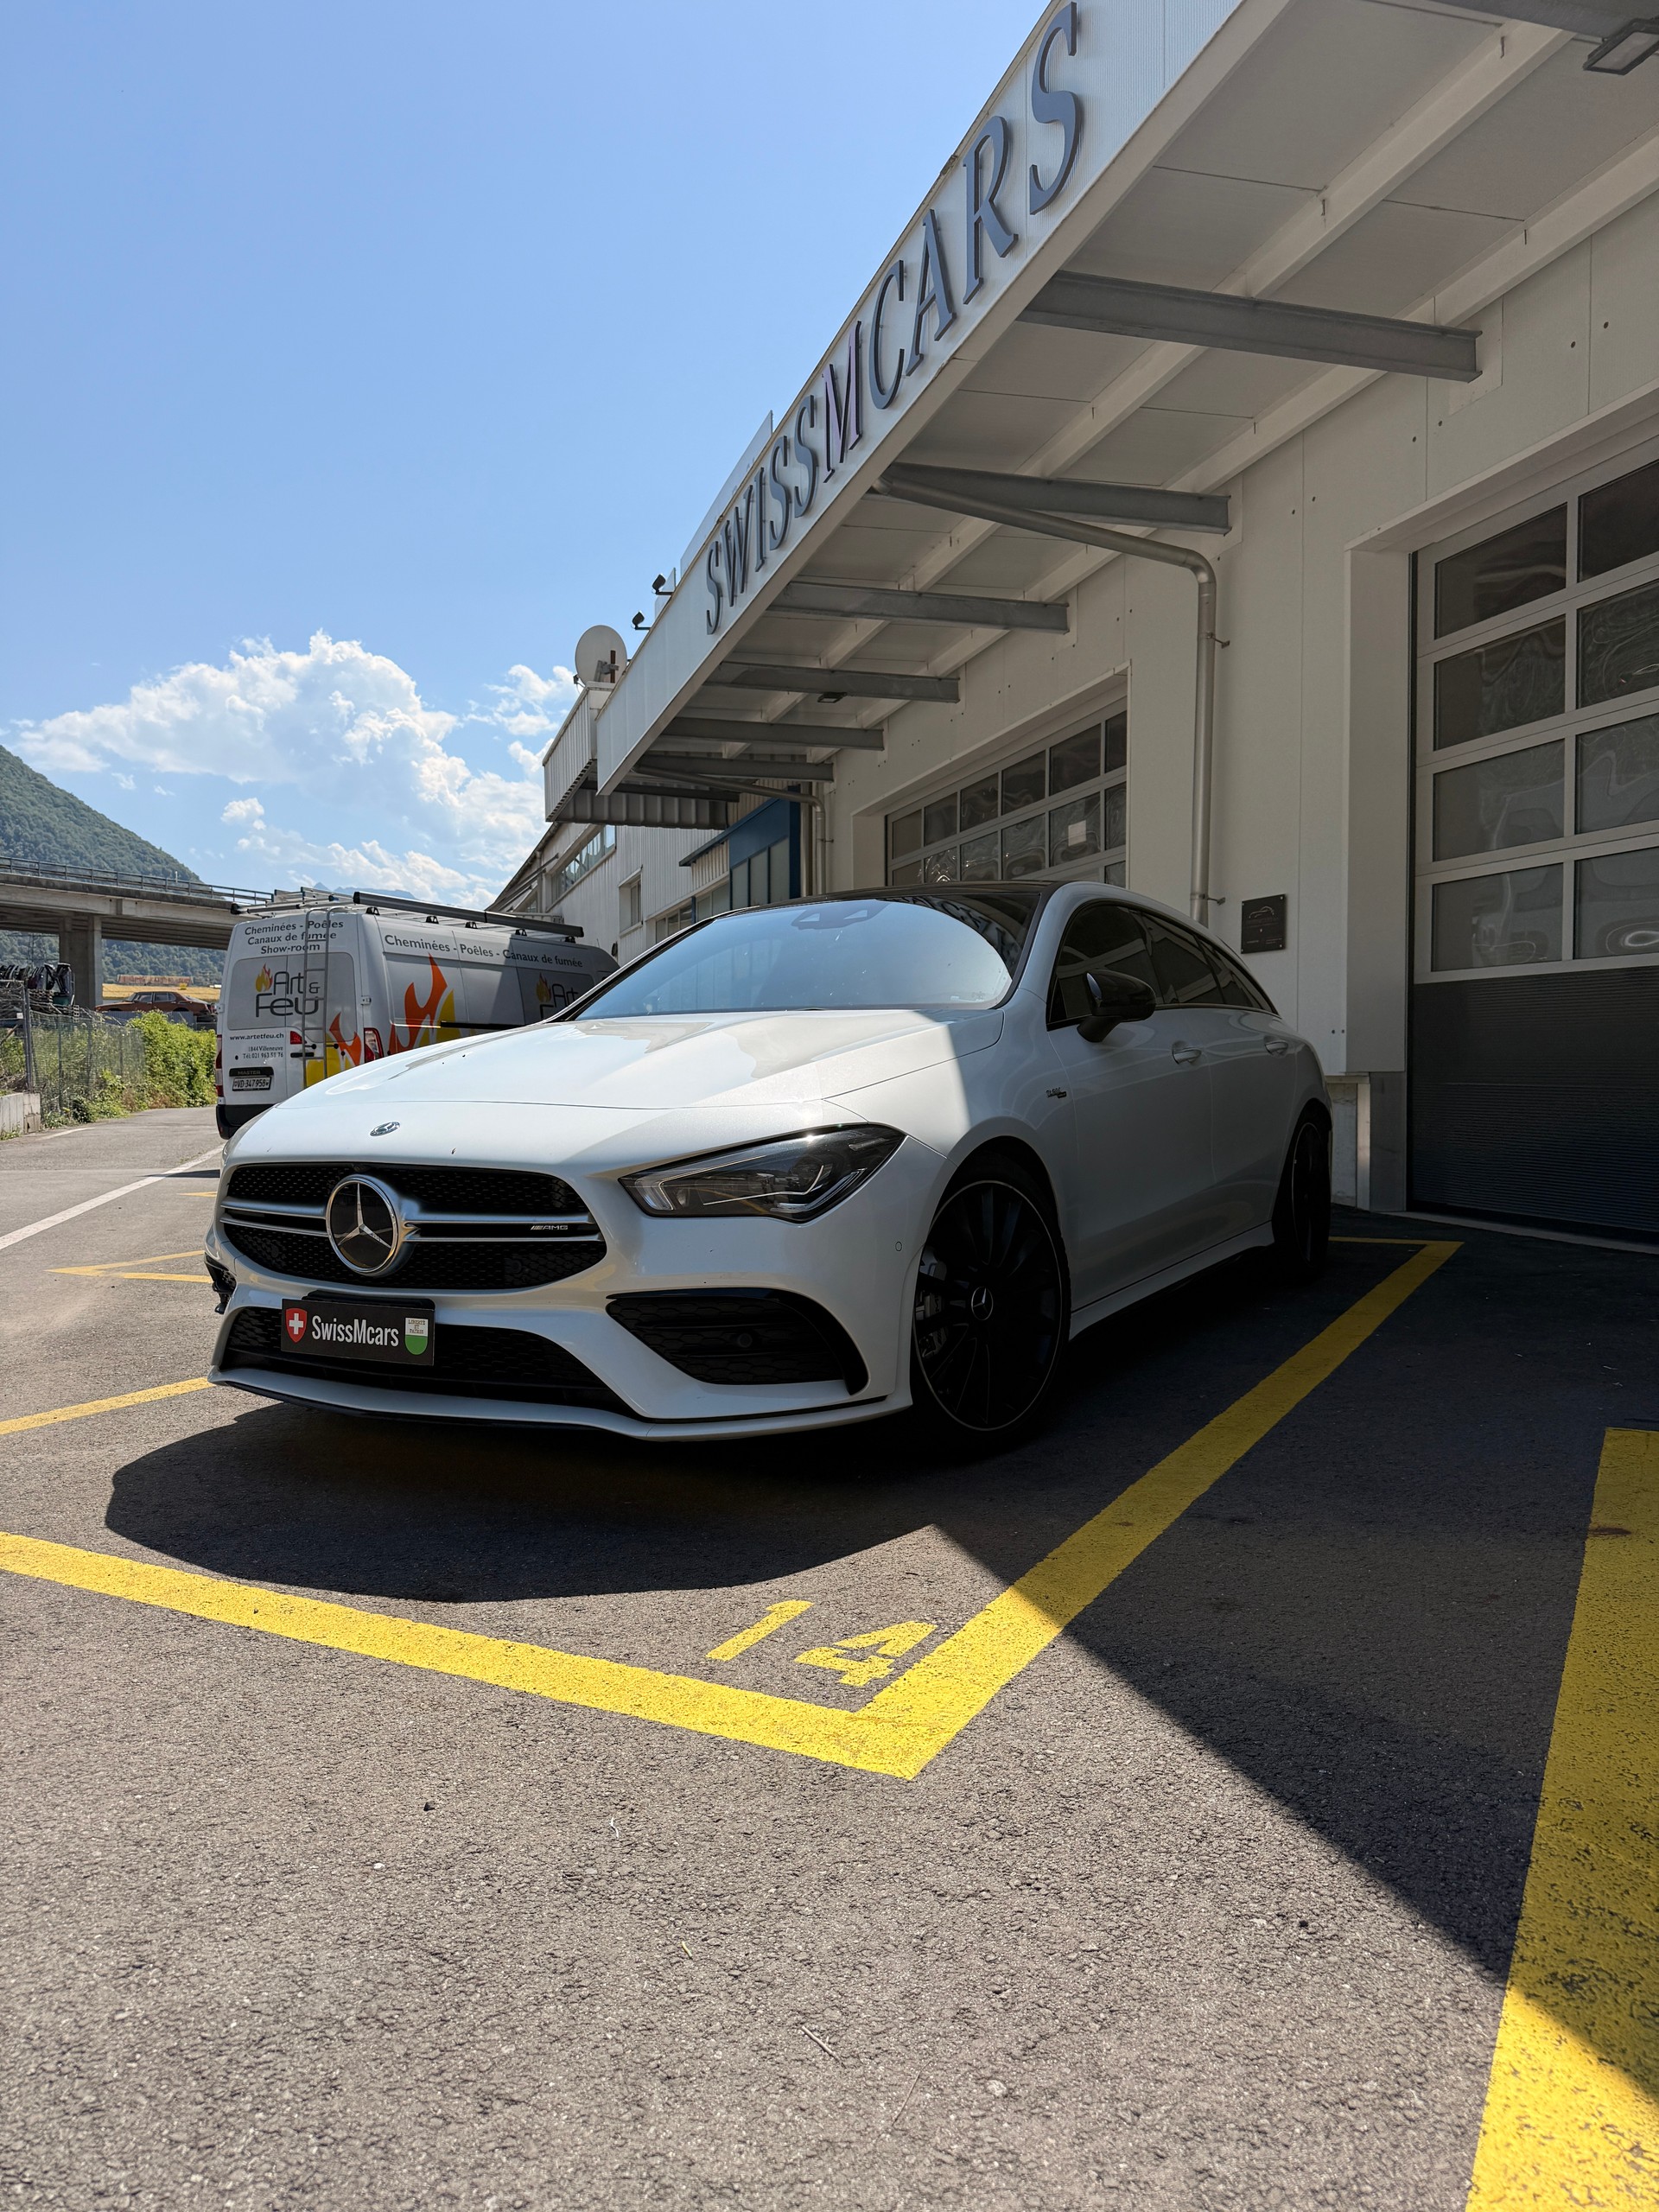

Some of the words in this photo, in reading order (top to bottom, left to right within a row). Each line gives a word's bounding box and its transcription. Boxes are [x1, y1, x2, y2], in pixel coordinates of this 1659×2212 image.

[705, 1, 1080, 635] SWISSMCARS
[245, 923, 296, 936] Cheminées
[247, 935, 282, 945] Canaux
[385, 934, 450, 952] Cheminées
[461, 944, 493, 957] Poêles
[503, 950, 538, 963] Canaux
[542, 954, 553, 964] de
[555, 955, 583, 968] fumée
[274, 971, 304, 995] Art
[256, 993, 319, 1018] Feu
[312, 1315, 399, 1347] SwissMcars
[705, 1599, 938, 1687] 14
